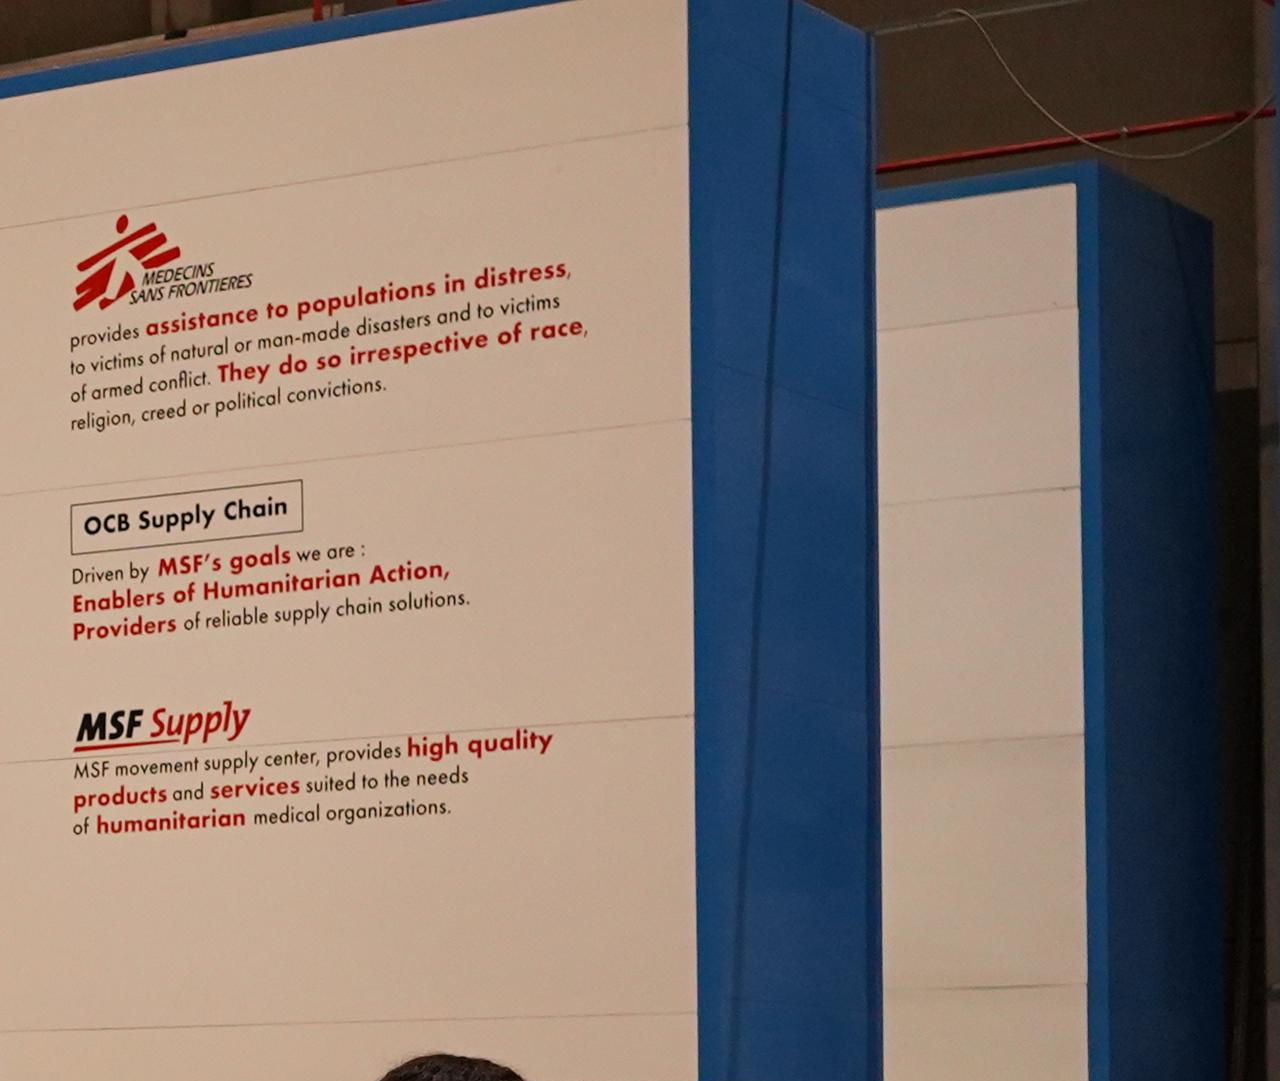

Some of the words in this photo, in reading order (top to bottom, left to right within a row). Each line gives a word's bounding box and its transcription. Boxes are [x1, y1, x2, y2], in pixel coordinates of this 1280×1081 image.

[129, 287, 166, 305] SANS
[168, 273, 253, 299] FRONTIERES
[142, 262, 214, 286] MEDECINS
[70, 323, 139, 352] provides
[146, 309, 258, 336] assistance
[266, 303, 288, 319] to
[298, 282, 436, 321] populations
[445, 273, 465, 294] in
[474, 264, 570, 289] distress,
[70, 361, 85, 375] to
[91, 353, 144, 372] victims
[150, 345, 166, 364] of
[171, 336, 228, 361] natural
[234, 340, 252, 353] or
[258, 320, 350, 350] man-made
[356, 315, 431, 336] disasters
[437, 302, 470, 324] and
[477, 304, 494, 318] to
[500, 294, 560, 315] victims
[71, 384, 86, 402] of
[92, 376, 143, 400] armed
[149, 370, 210, 392] conflict.
[217, 362, 270, 384] They
[279, 354, 308, 375] do
[316, 354, 342, 370] so
[350, 331, 488, 365] irrespective
[498, 322, 522, 345] of
[531, 321, 587, 341] race,
[72, 410, 135, 432] religion,
[142, 398, 186, 422] creed
[192, 403, 210, 416] or
[216, 386, 280, 418] political
[287, 379, 386, 403] convictions.
[84, 513, 130, 535] OCB
[139, 504, 216, 533] Supply
[224, 496, 287, 520] Chain
[72, 567, 123, 584] Driven
[130, 562, 149, 583] by
[230, 544, 290, 575] goals
[296, 550, 320, 562] we
[327, 546, 355, 559] are
[73, 588, 165, 613] Enablers
[173, 582, 195, 603] of
[204, 569, 360, 600] Humanitarian
[370, 560, 449, 584] Action,
[73, 615, 176, 641] Providers
[184, 611, 200, 630] of
[206, 606, 268, 628] reliable
[275, 600, 330, 626] supply
[336, 597, 382, 616] chain
[389, 592, 470, 612] solutions.
[76, 709, 143, 742] MSF
[150, 701, 251, 743] Supply
[74, 761, 109, 779] MSF
[116, 757, 199, 776] movement
[204, 750, 258, 775] supply
[264, 750, 320, 767] center,
[327, 741, 401, 768] provides
[408, 734, 458, 762] high
[468, 728, 553, 759] quality
[74, 785, 167, 814] products
[173, 782, 204, 801] and
[210, 776, 300, 799] services
[306, 772, 356, 793] suited
[362, 775, 378, 789] to
[384, 770, 410, 788] the
[417, 765, 468, 786] needs
[73, 816, 89, 835] of
[97, 808, 245, 834] humanitarian
[254, 803, 320, 824] medical
[326, 799, 451, 825] organizations.
